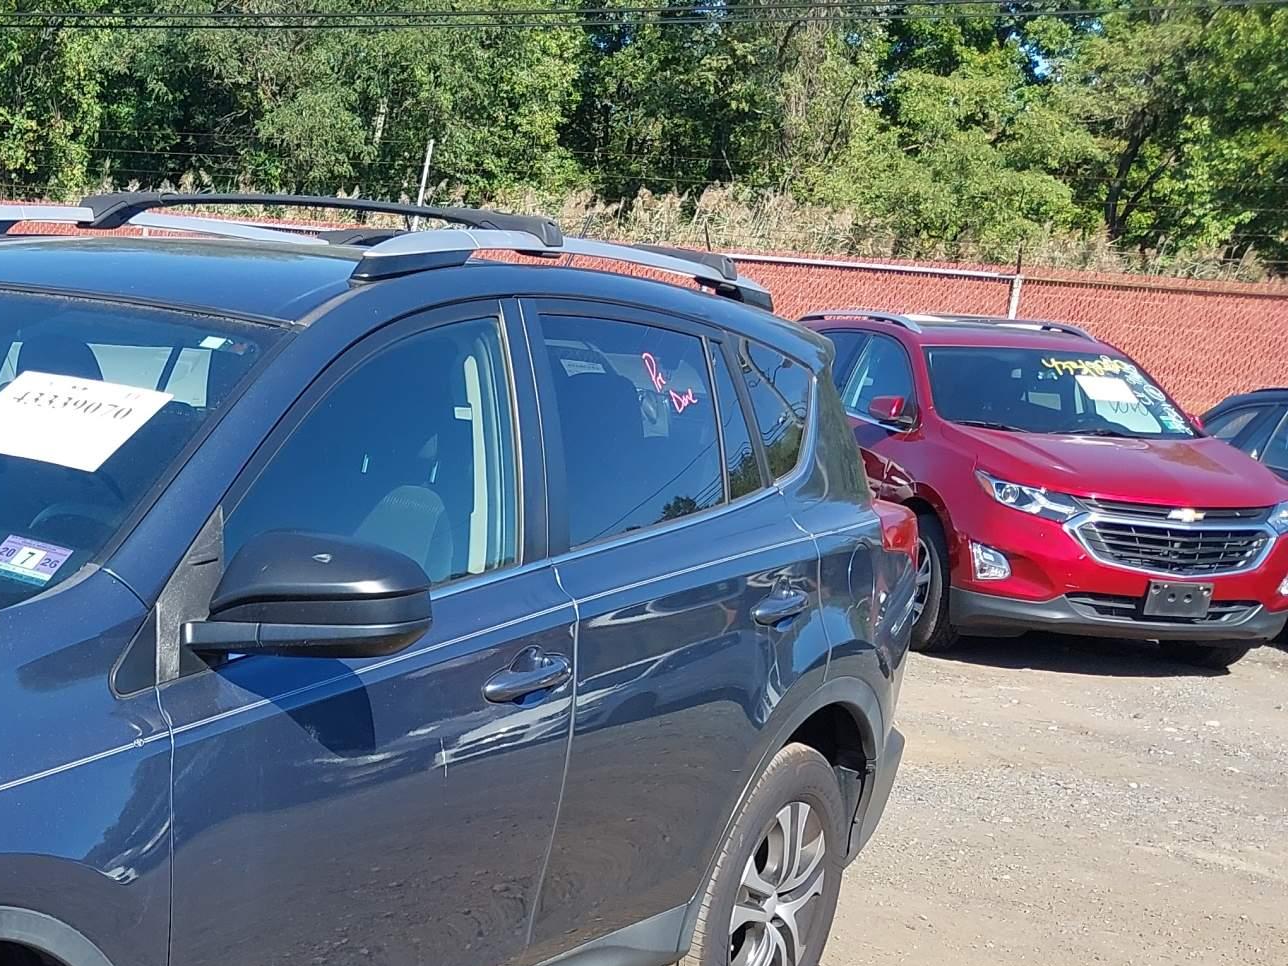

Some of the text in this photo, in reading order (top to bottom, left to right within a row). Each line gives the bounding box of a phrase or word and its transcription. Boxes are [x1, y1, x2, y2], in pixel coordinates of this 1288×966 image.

[13, 391, 133, 420] 43339070
[20, 551, 36, 565] 7
[40, 558, 60, 569] 26
